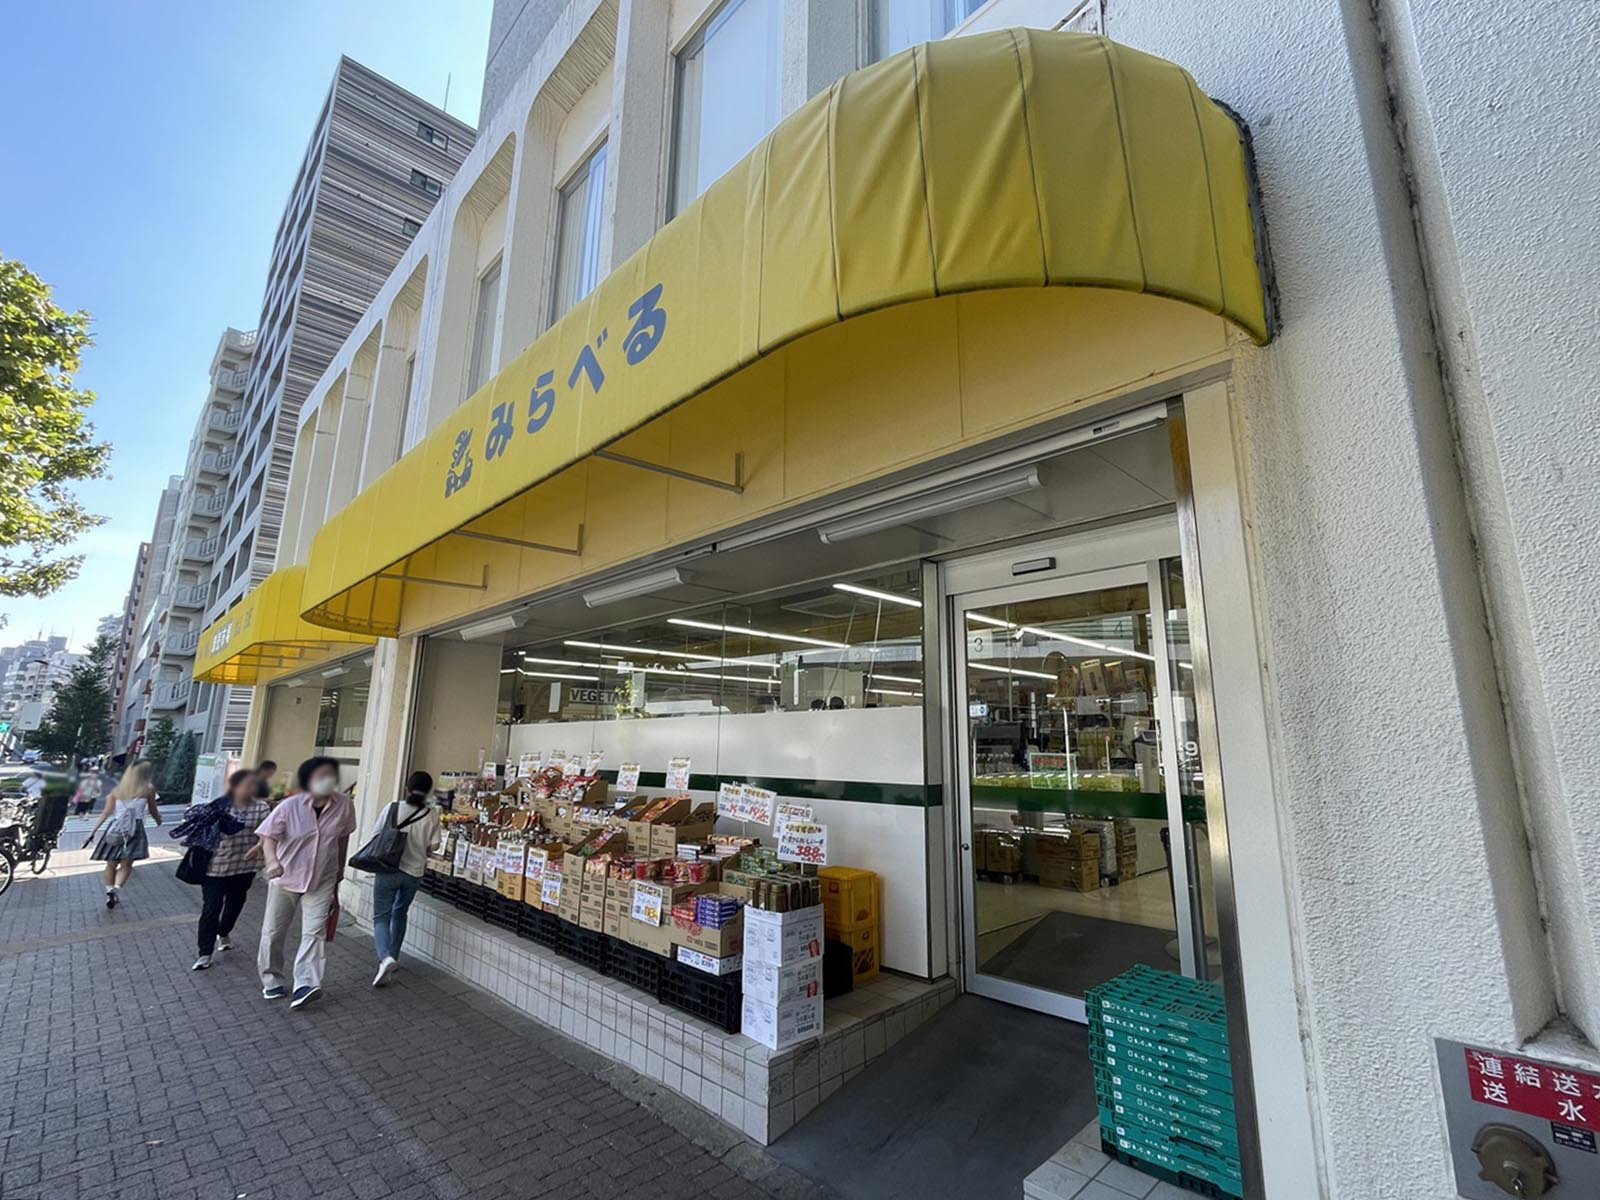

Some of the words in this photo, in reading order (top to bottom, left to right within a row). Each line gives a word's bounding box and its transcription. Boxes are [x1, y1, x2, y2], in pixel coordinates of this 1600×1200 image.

[485, 283, 667, 462] みらべる
[974, 637, 984, 653] 3
